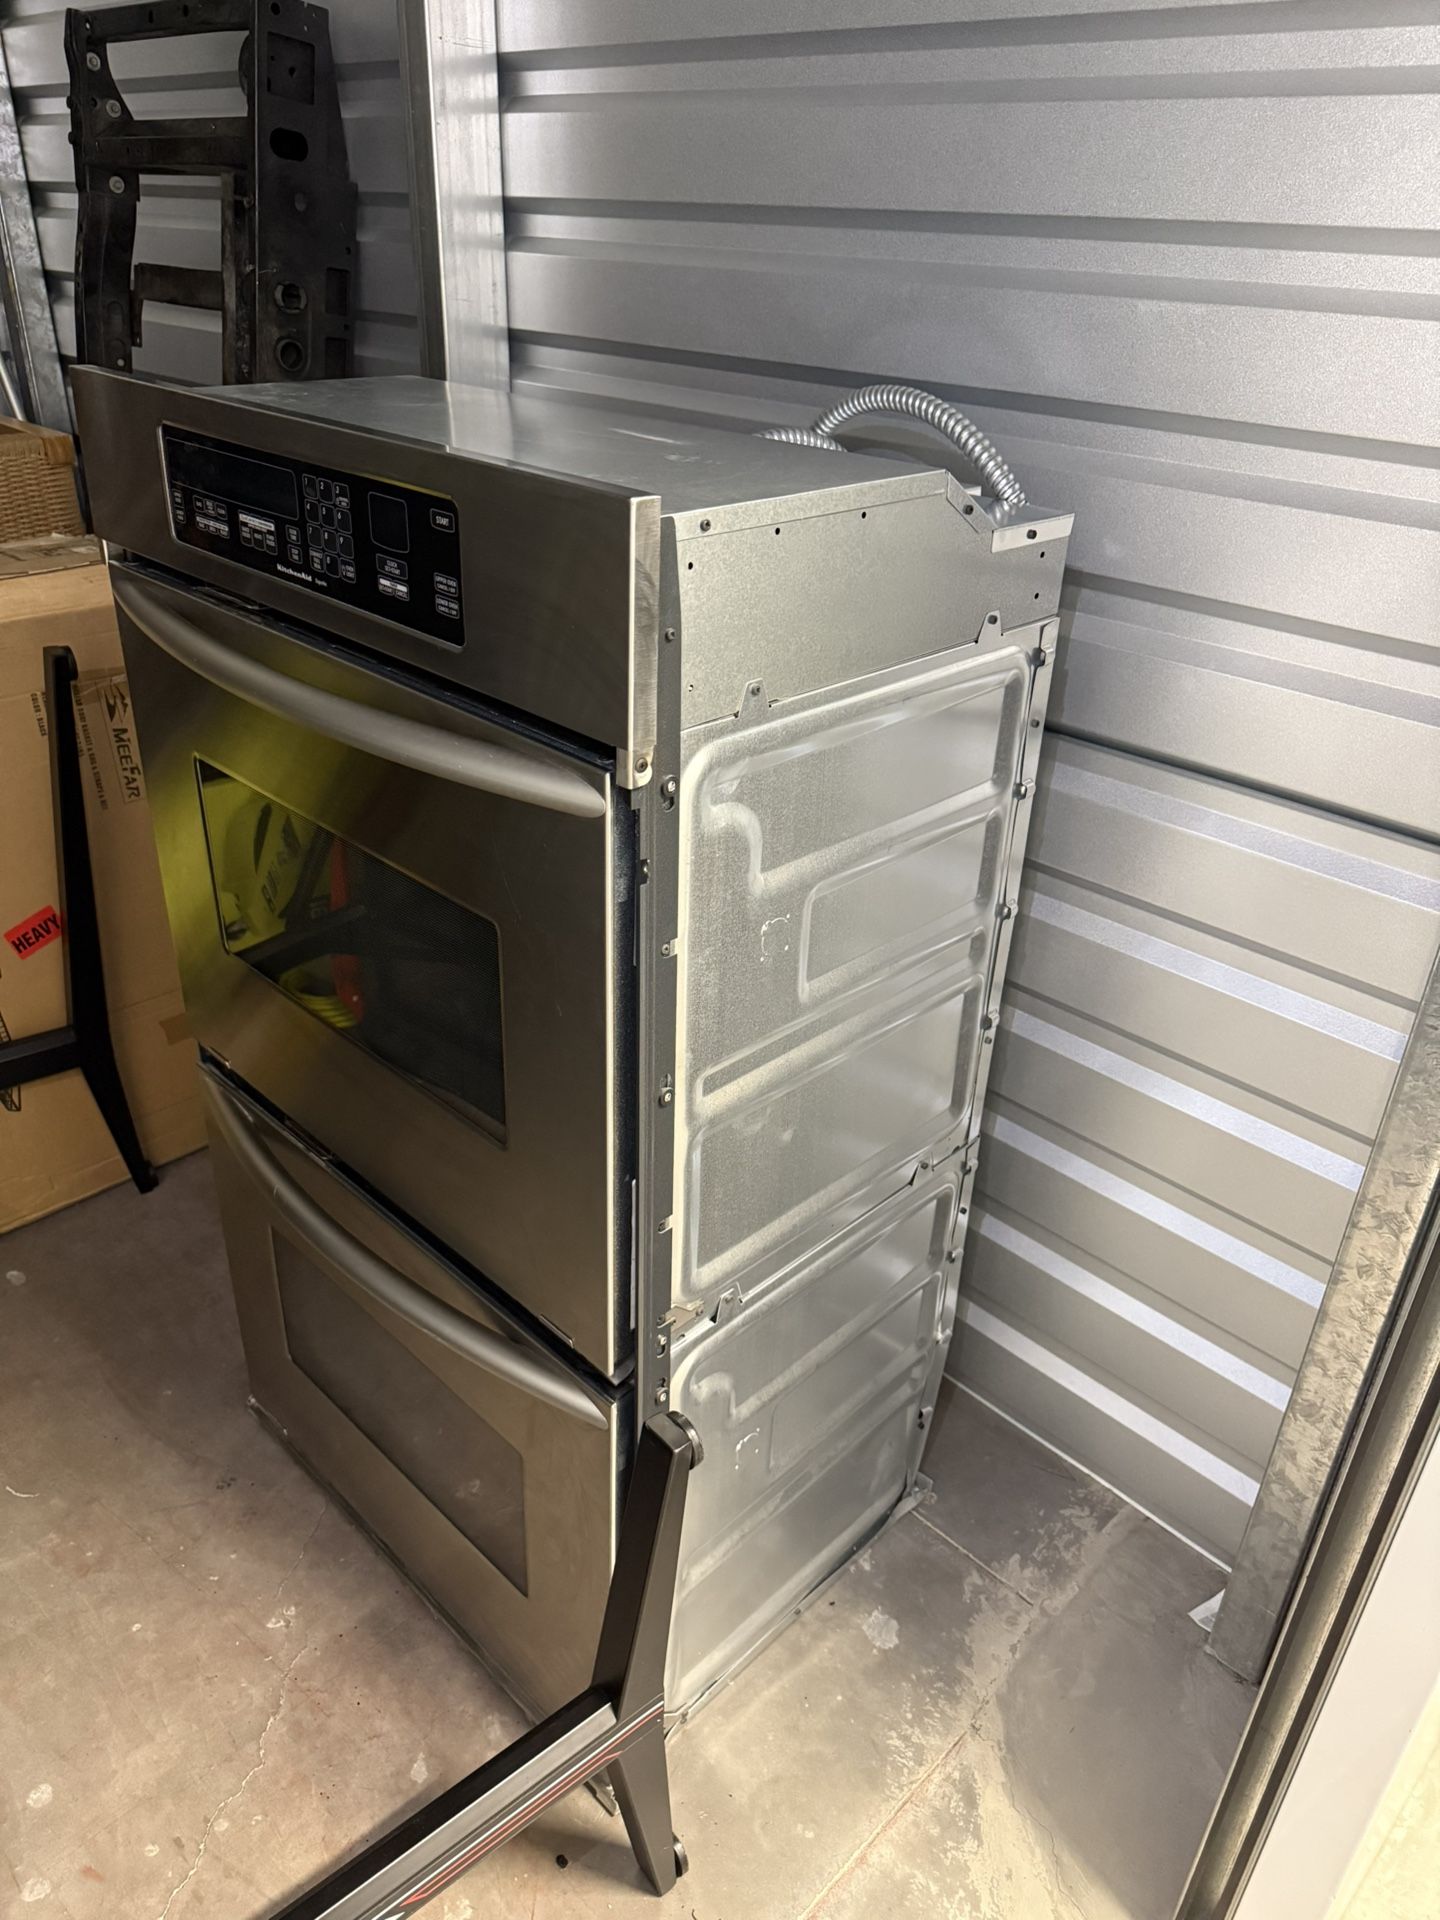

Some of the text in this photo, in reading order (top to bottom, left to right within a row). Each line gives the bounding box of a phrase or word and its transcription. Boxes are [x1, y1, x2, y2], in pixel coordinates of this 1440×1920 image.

[435, 515, 450, 527] START
[276, 562, 313, 582] KitchenAid
[11, 913, 60, 954] HEAVY
